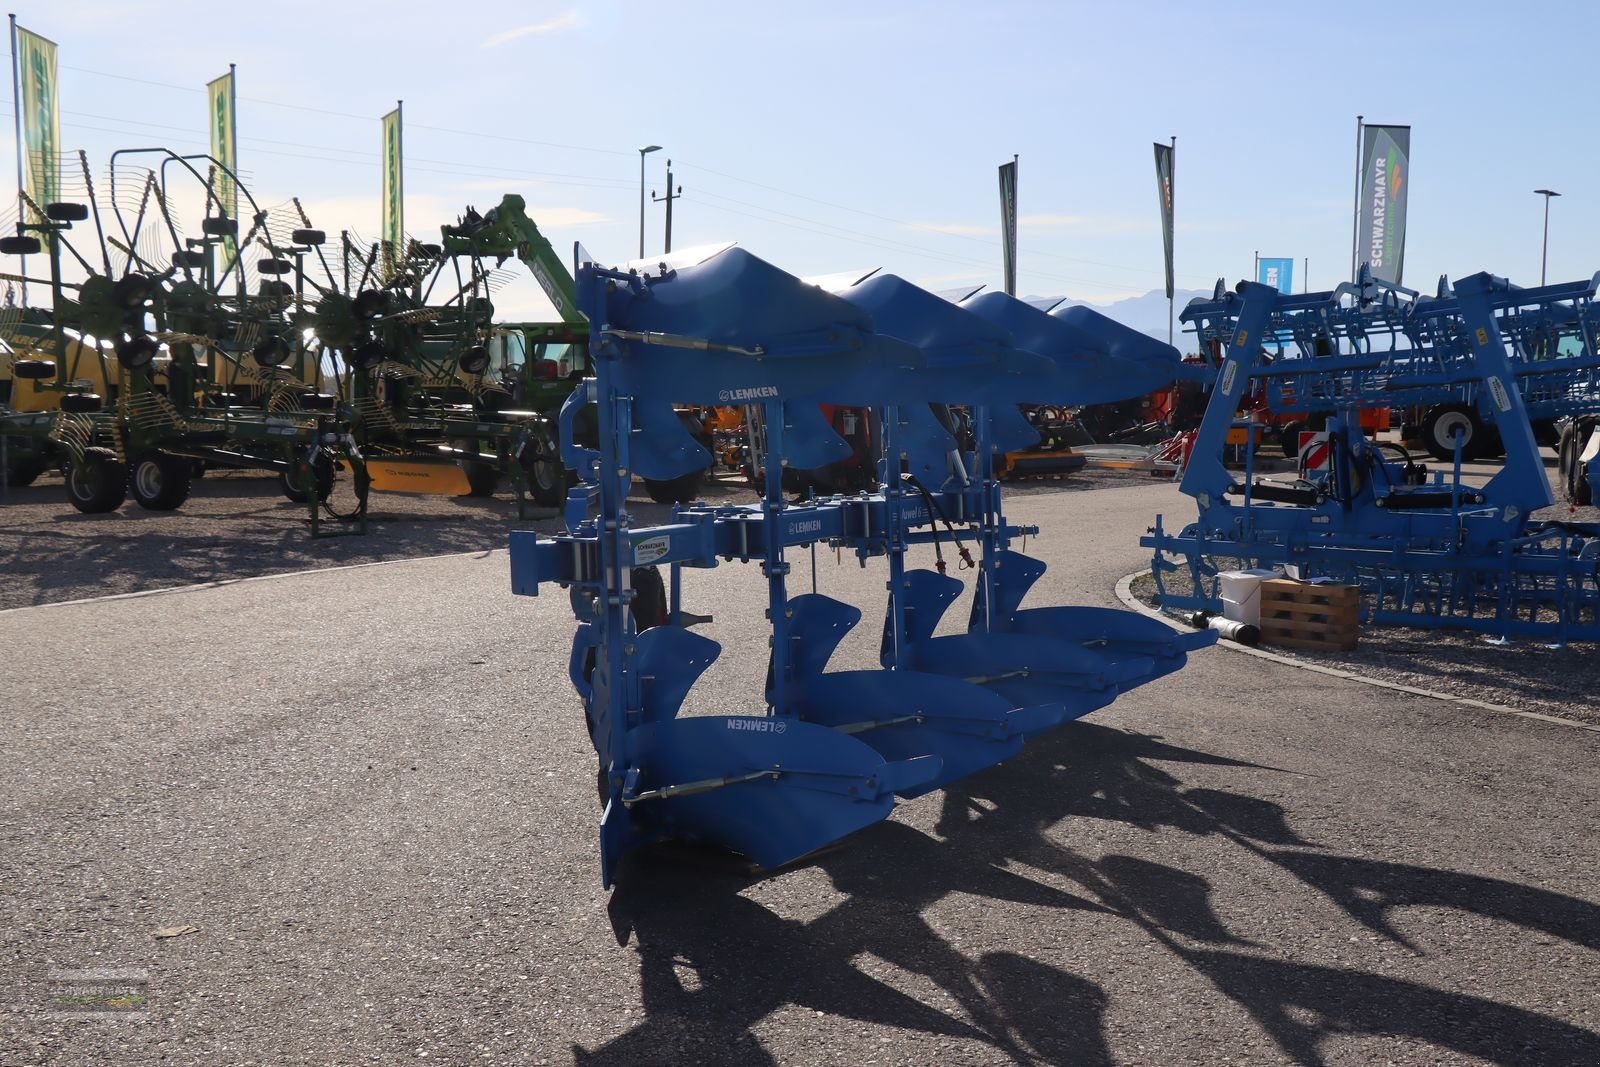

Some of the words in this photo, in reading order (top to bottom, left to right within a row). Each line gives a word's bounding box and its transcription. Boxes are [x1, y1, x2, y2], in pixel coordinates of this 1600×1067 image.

[1371, 158, 1386, 267] SCHWARZMAYR
[532, 263, 563, 311] MERLO
[729, 386, 778, 400] LEMKEN
[795, 520, 821, 533] LEMKEN
[727, 719, 774, 732] LEMKEN
